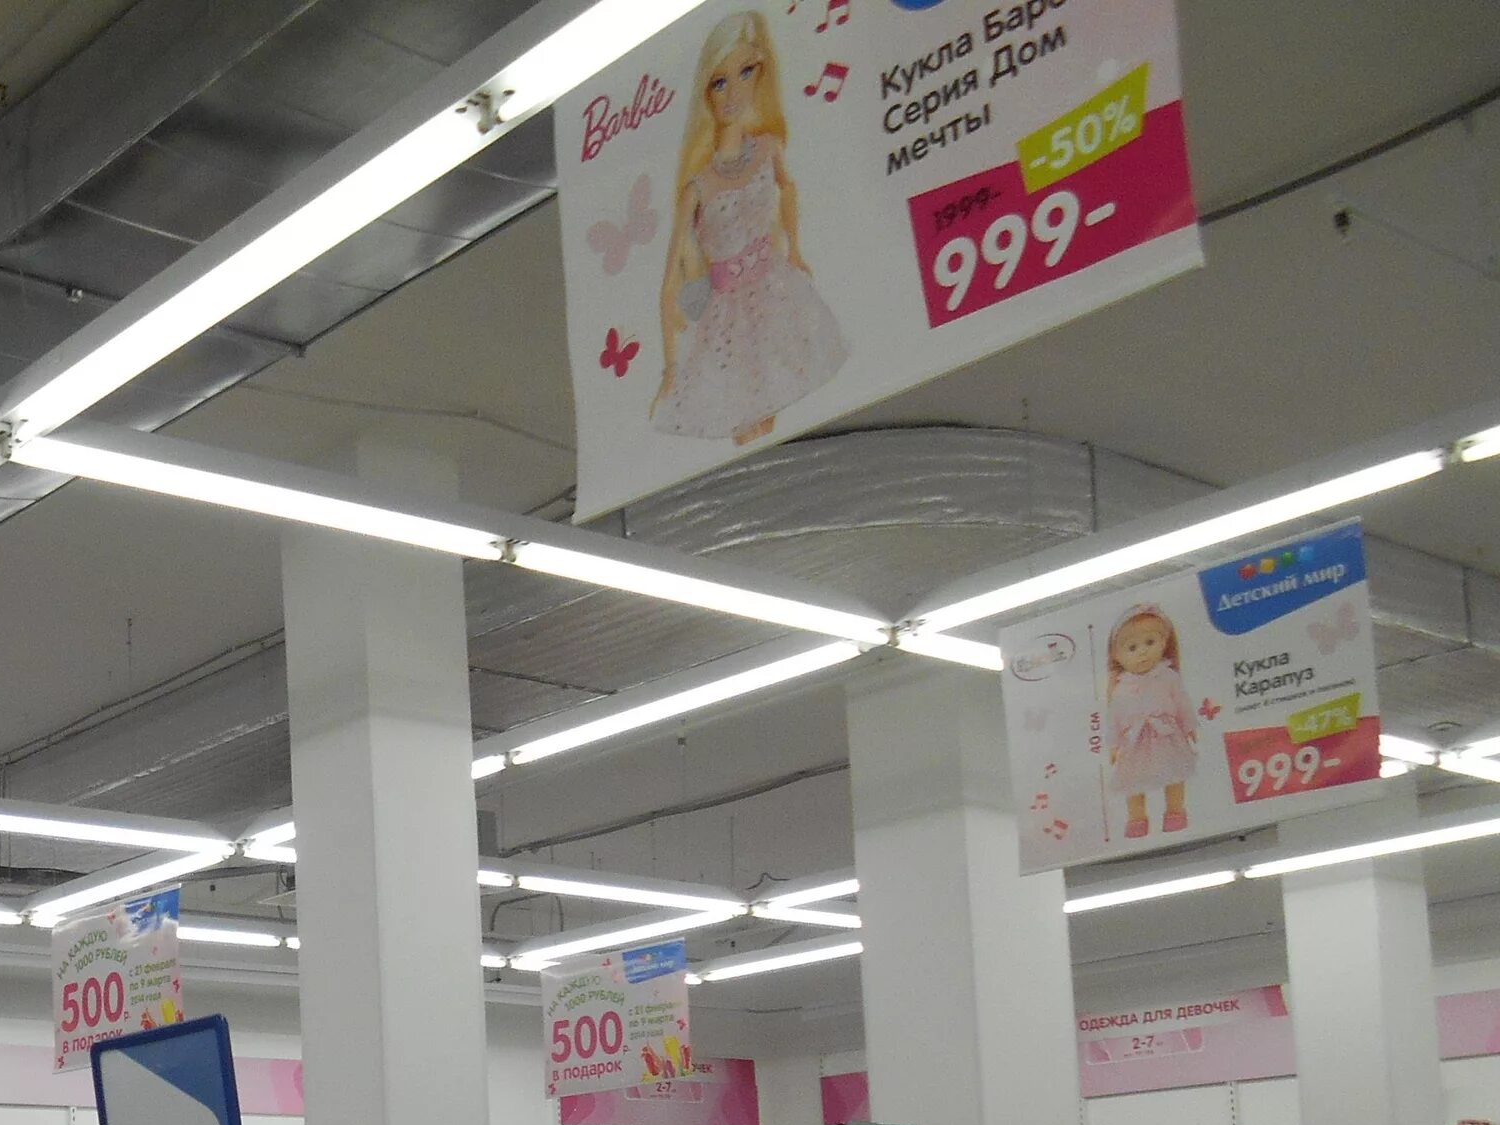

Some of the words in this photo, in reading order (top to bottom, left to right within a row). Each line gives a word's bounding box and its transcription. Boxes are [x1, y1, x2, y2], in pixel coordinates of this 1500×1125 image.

[880, 31, 974, 100] Кукла
[882, 69, 978, 134] Серия
[989, 25, 1068, 88] Дом
[581, 73, 675, 162] Barbie
[886, 103, 991, 175] мечты
[1029, 95, 1137, 170] -50%
[933, 190, 1117, 311] 999-
[1233, 652, 1290, 678] Кукла
[1234, 667, 1315, 699] Карапуз
[1237, 745, 1342, 797] 999-
[61, 972, 125, 1033] 500
[1080, 1012, 1139, 1032] ОДЕЖДА
[1143, 1007, 1173, 1024] ДЛЯ
[1177, 997, 1240, 1020] ДЕВОЧЕК
[551, 1010, 623, 1063] 500
[1132, 1035, 1155, 1050] 2-7
[563, 1059, 623, 1081] подарок
